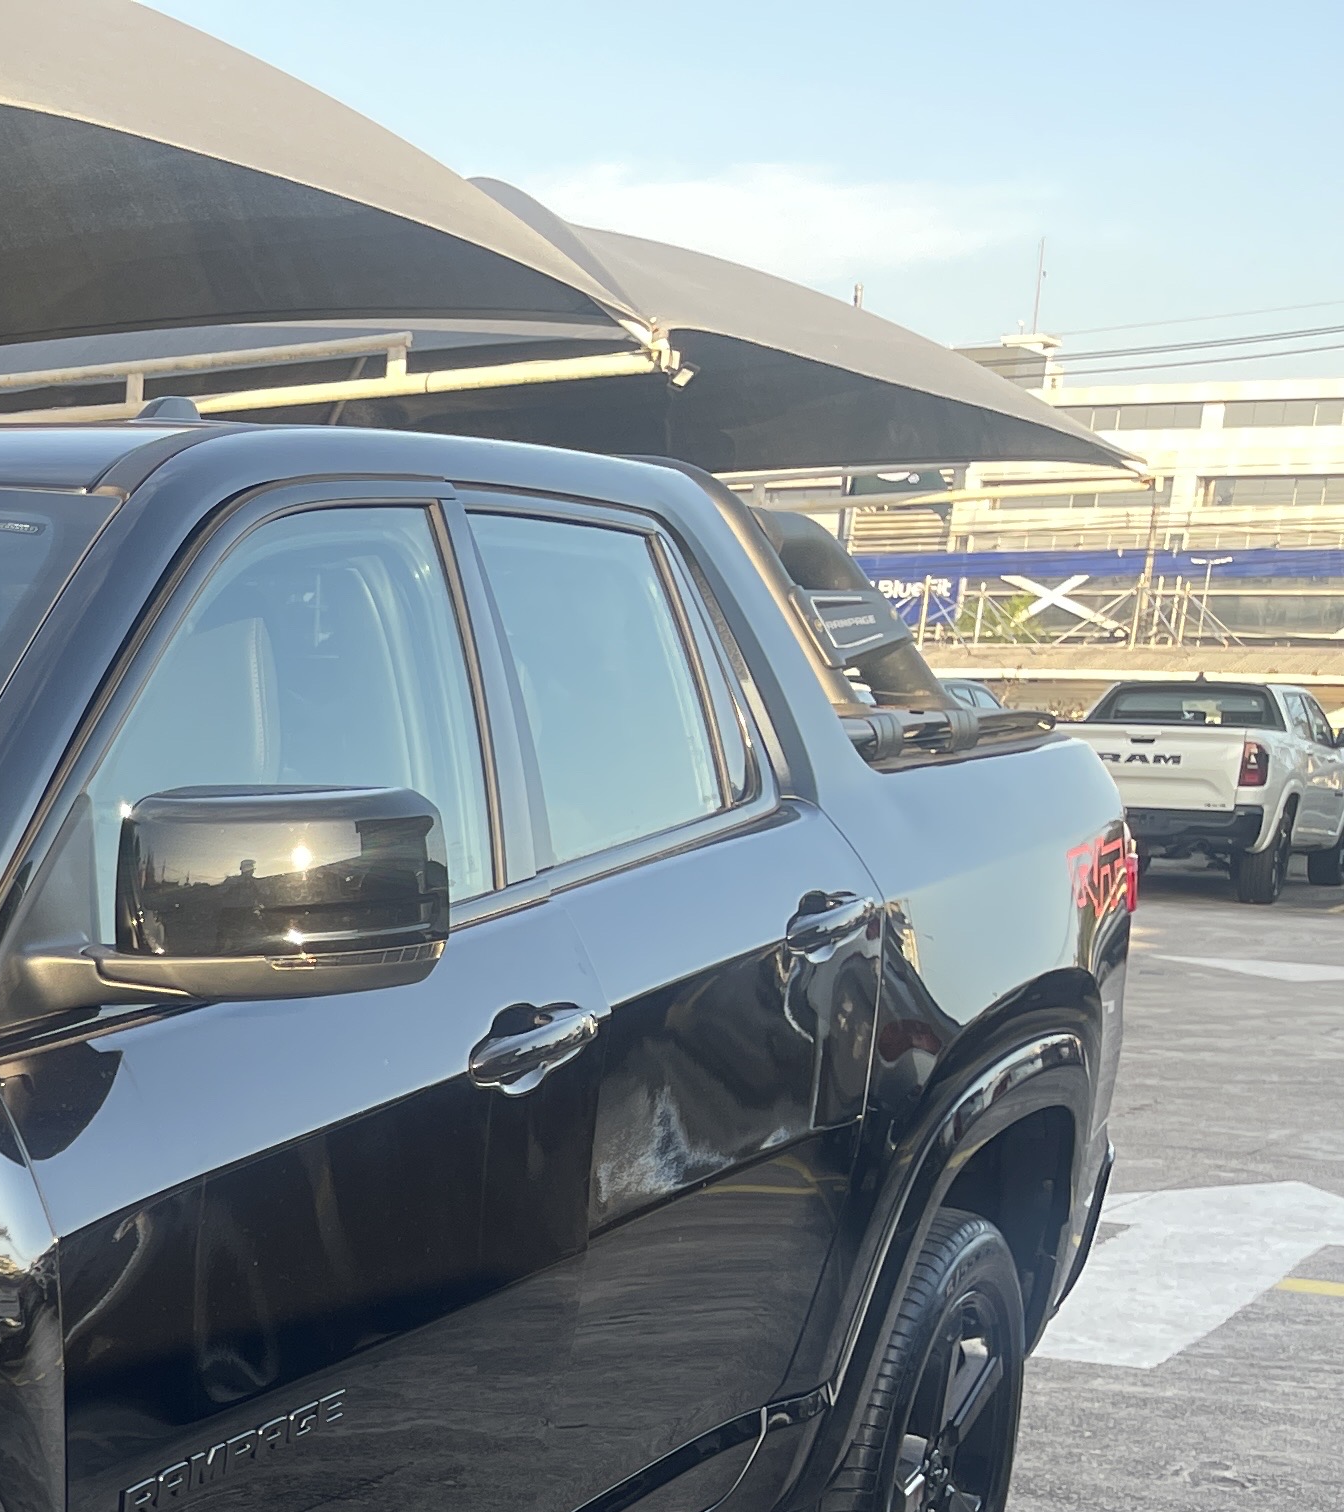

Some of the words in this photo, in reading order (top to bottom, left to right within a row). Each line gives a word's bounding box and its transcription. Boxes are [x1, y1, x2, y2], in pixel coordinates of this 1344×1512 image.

[878, 577, 952, 599] BlueFit
[825, 614, 876, 631] RAMPAGE
[1100, 752, 1182, 766] RAM
